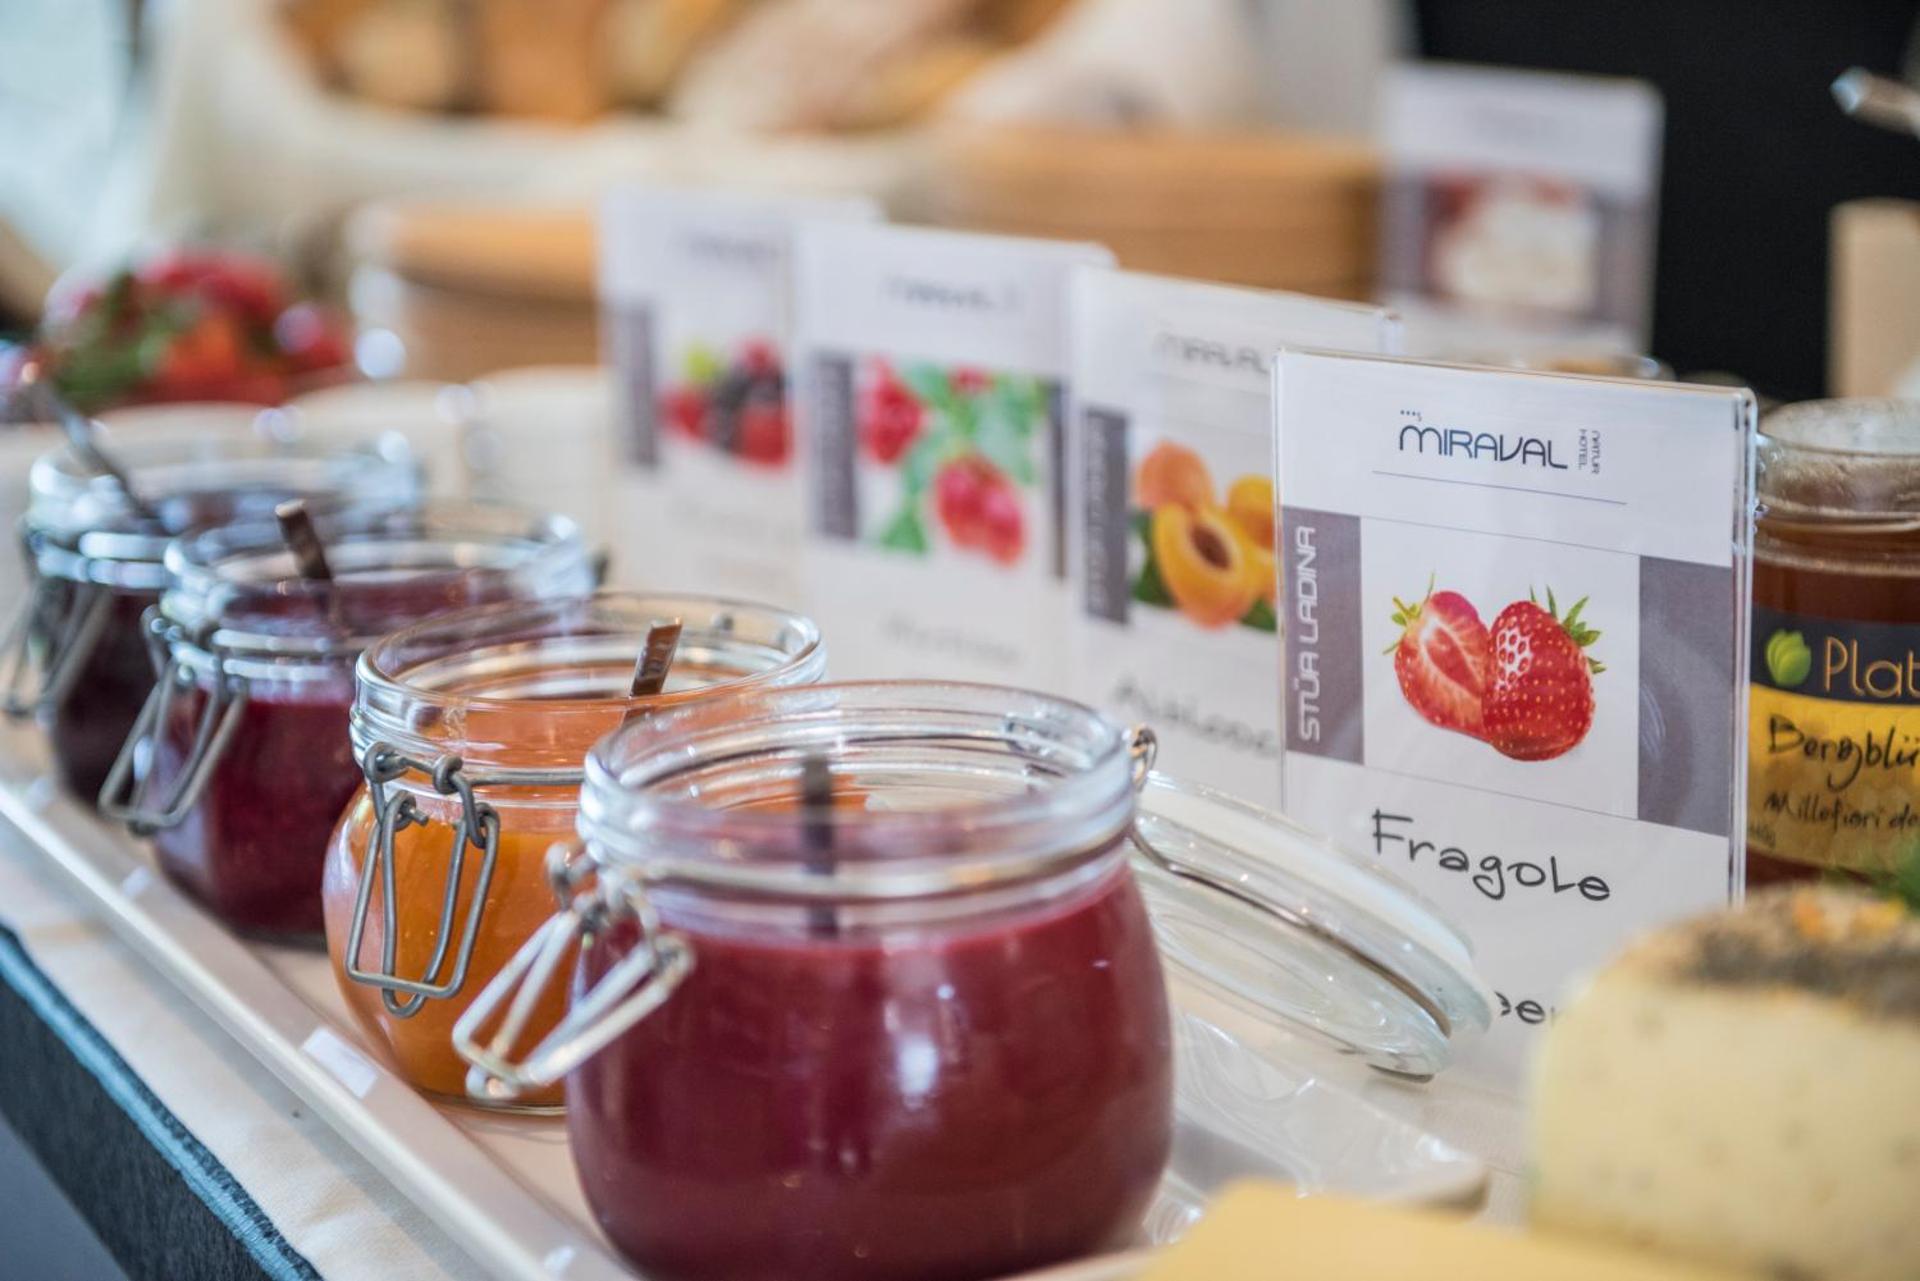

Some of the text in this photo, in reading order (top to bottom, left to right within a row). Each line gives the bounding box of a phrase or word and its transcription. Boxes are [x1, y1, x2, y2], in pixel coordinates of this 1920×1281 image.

[1399, 424, 1568, 469] MIRAVAL
[1578, 428, 1588, 470] HOTEL
[1295, 525, 1319, 644] LADINA
